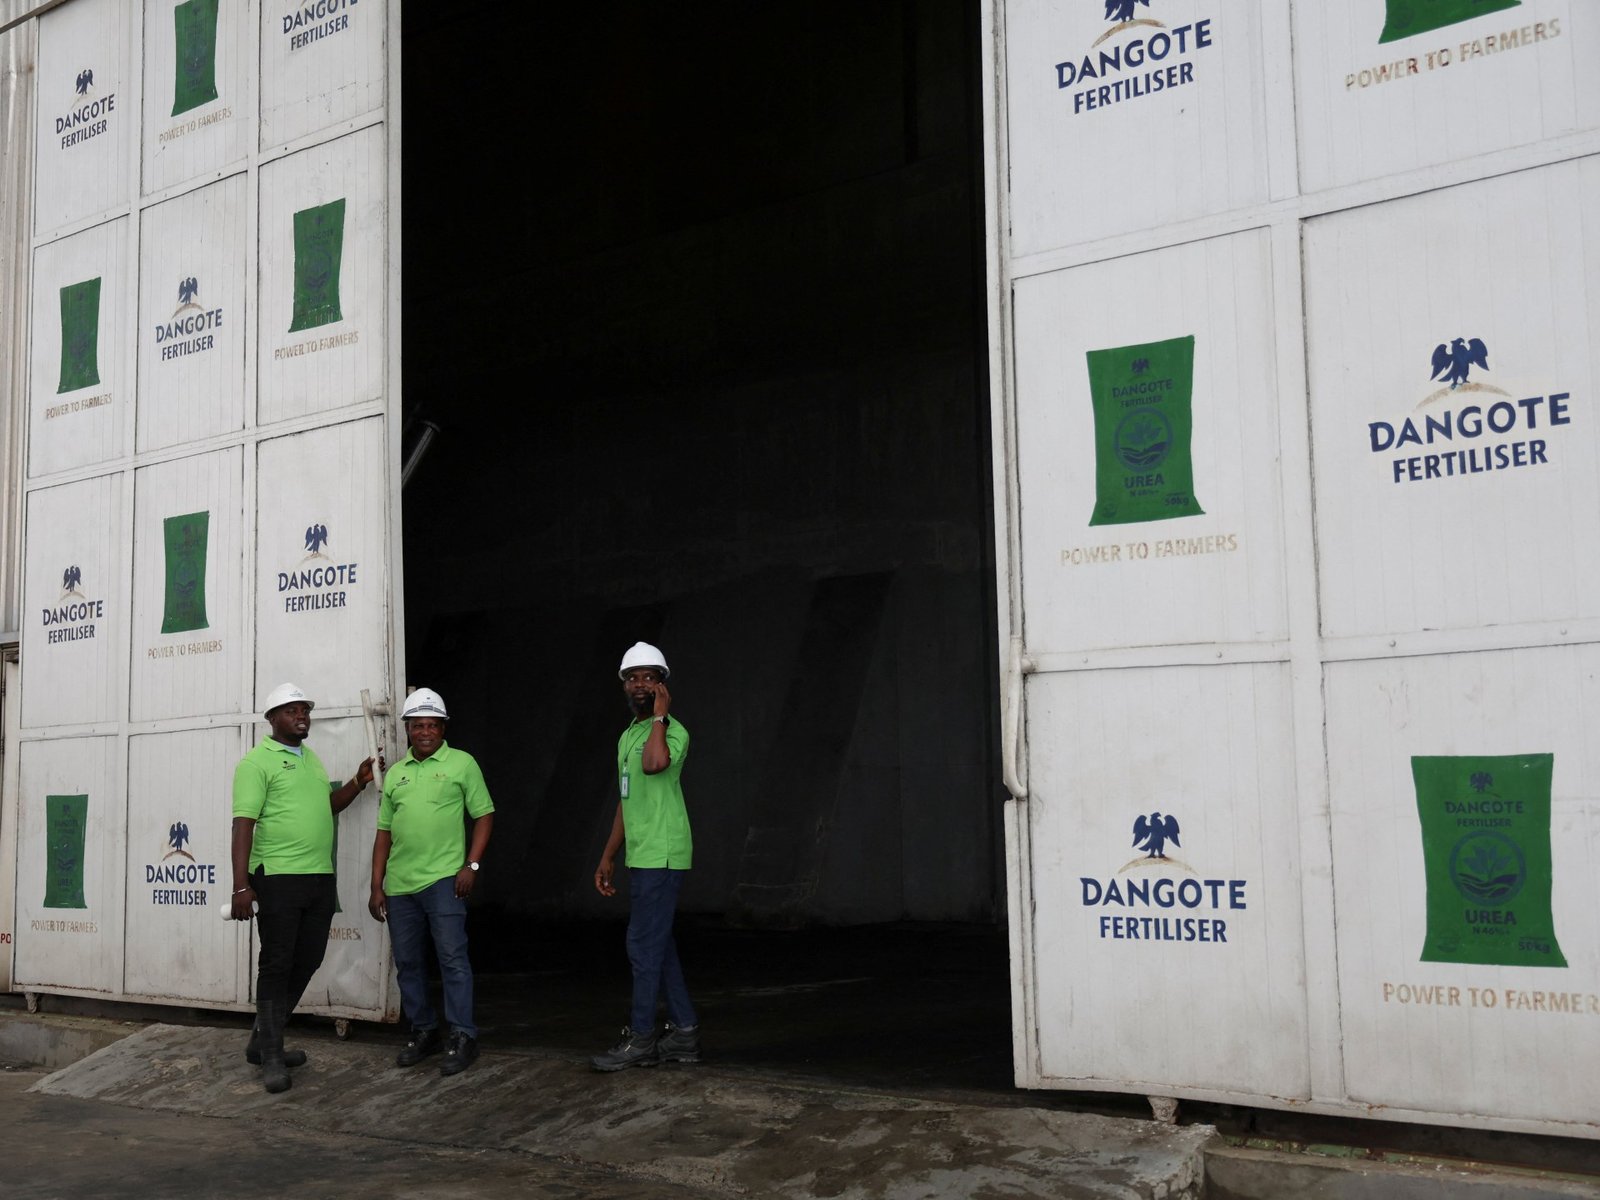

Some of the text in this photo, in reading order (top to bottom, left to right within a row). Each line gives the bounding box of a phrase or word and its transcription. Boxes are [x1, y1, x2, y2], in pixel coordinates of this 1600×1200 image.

[283, 0, 357, 34] DANGO
[291, 15, 348, 51] FERTILISER
[1054, 18, 1212, 90] DANGOTE
[1345, 18, 1561, 91] POWER TO FARMERS
[1073, 62, 1194, 115] FERTILISER
[56, 94, 115, 134] DANGOTE
[159, 106, 232, 144] POWER TO FARMERS
[61, 119, 107, 150] FERTILISER
[156, 308, 222, 343] DANGOTE
[162, 335, 213, 361] FERTILISER
[274, 331, 359, 360] POWER TO FARMERS
[1112, 378, 1173, 398] DANGOTE
[46, 393, 112, 420] POWER TO FARMERS
[1367, 392, 1571, 453] DANGOTE
[1392, 439, 1549, 484] FERTILISER
[1125, 473, 1165, 489] UREA
[1060, 534, 1238, 566] POWER TO FARMERS
[278, 563, 357, 591] DANGOTE
[43, 600, 103, 625] DANGOTE
[286, 591, 346, 613] FERTILISER
[48, 625, 95, 644] FERTILISER
[148, 640, 223, 660] POWER TO FARMERS
[1444, 801, 1525, 815] DANGOTE
[1456, 818, 1512, 828] FERTILISER
[146, 864, 216, 885] DANGOTE
[152, 889, 207, 906] FERTILISER
[1080, 877, 1247, 910] DANGOTE
[31, 920, 98, 933] POWER TO FARMERS
[1100, 916, 1228, 943] FERTILISER
[1464, 909, 1517, 926] UREA
[1383, 982, 1462, 1007] POWER
[1467, 986, 1497, 1008] TO
